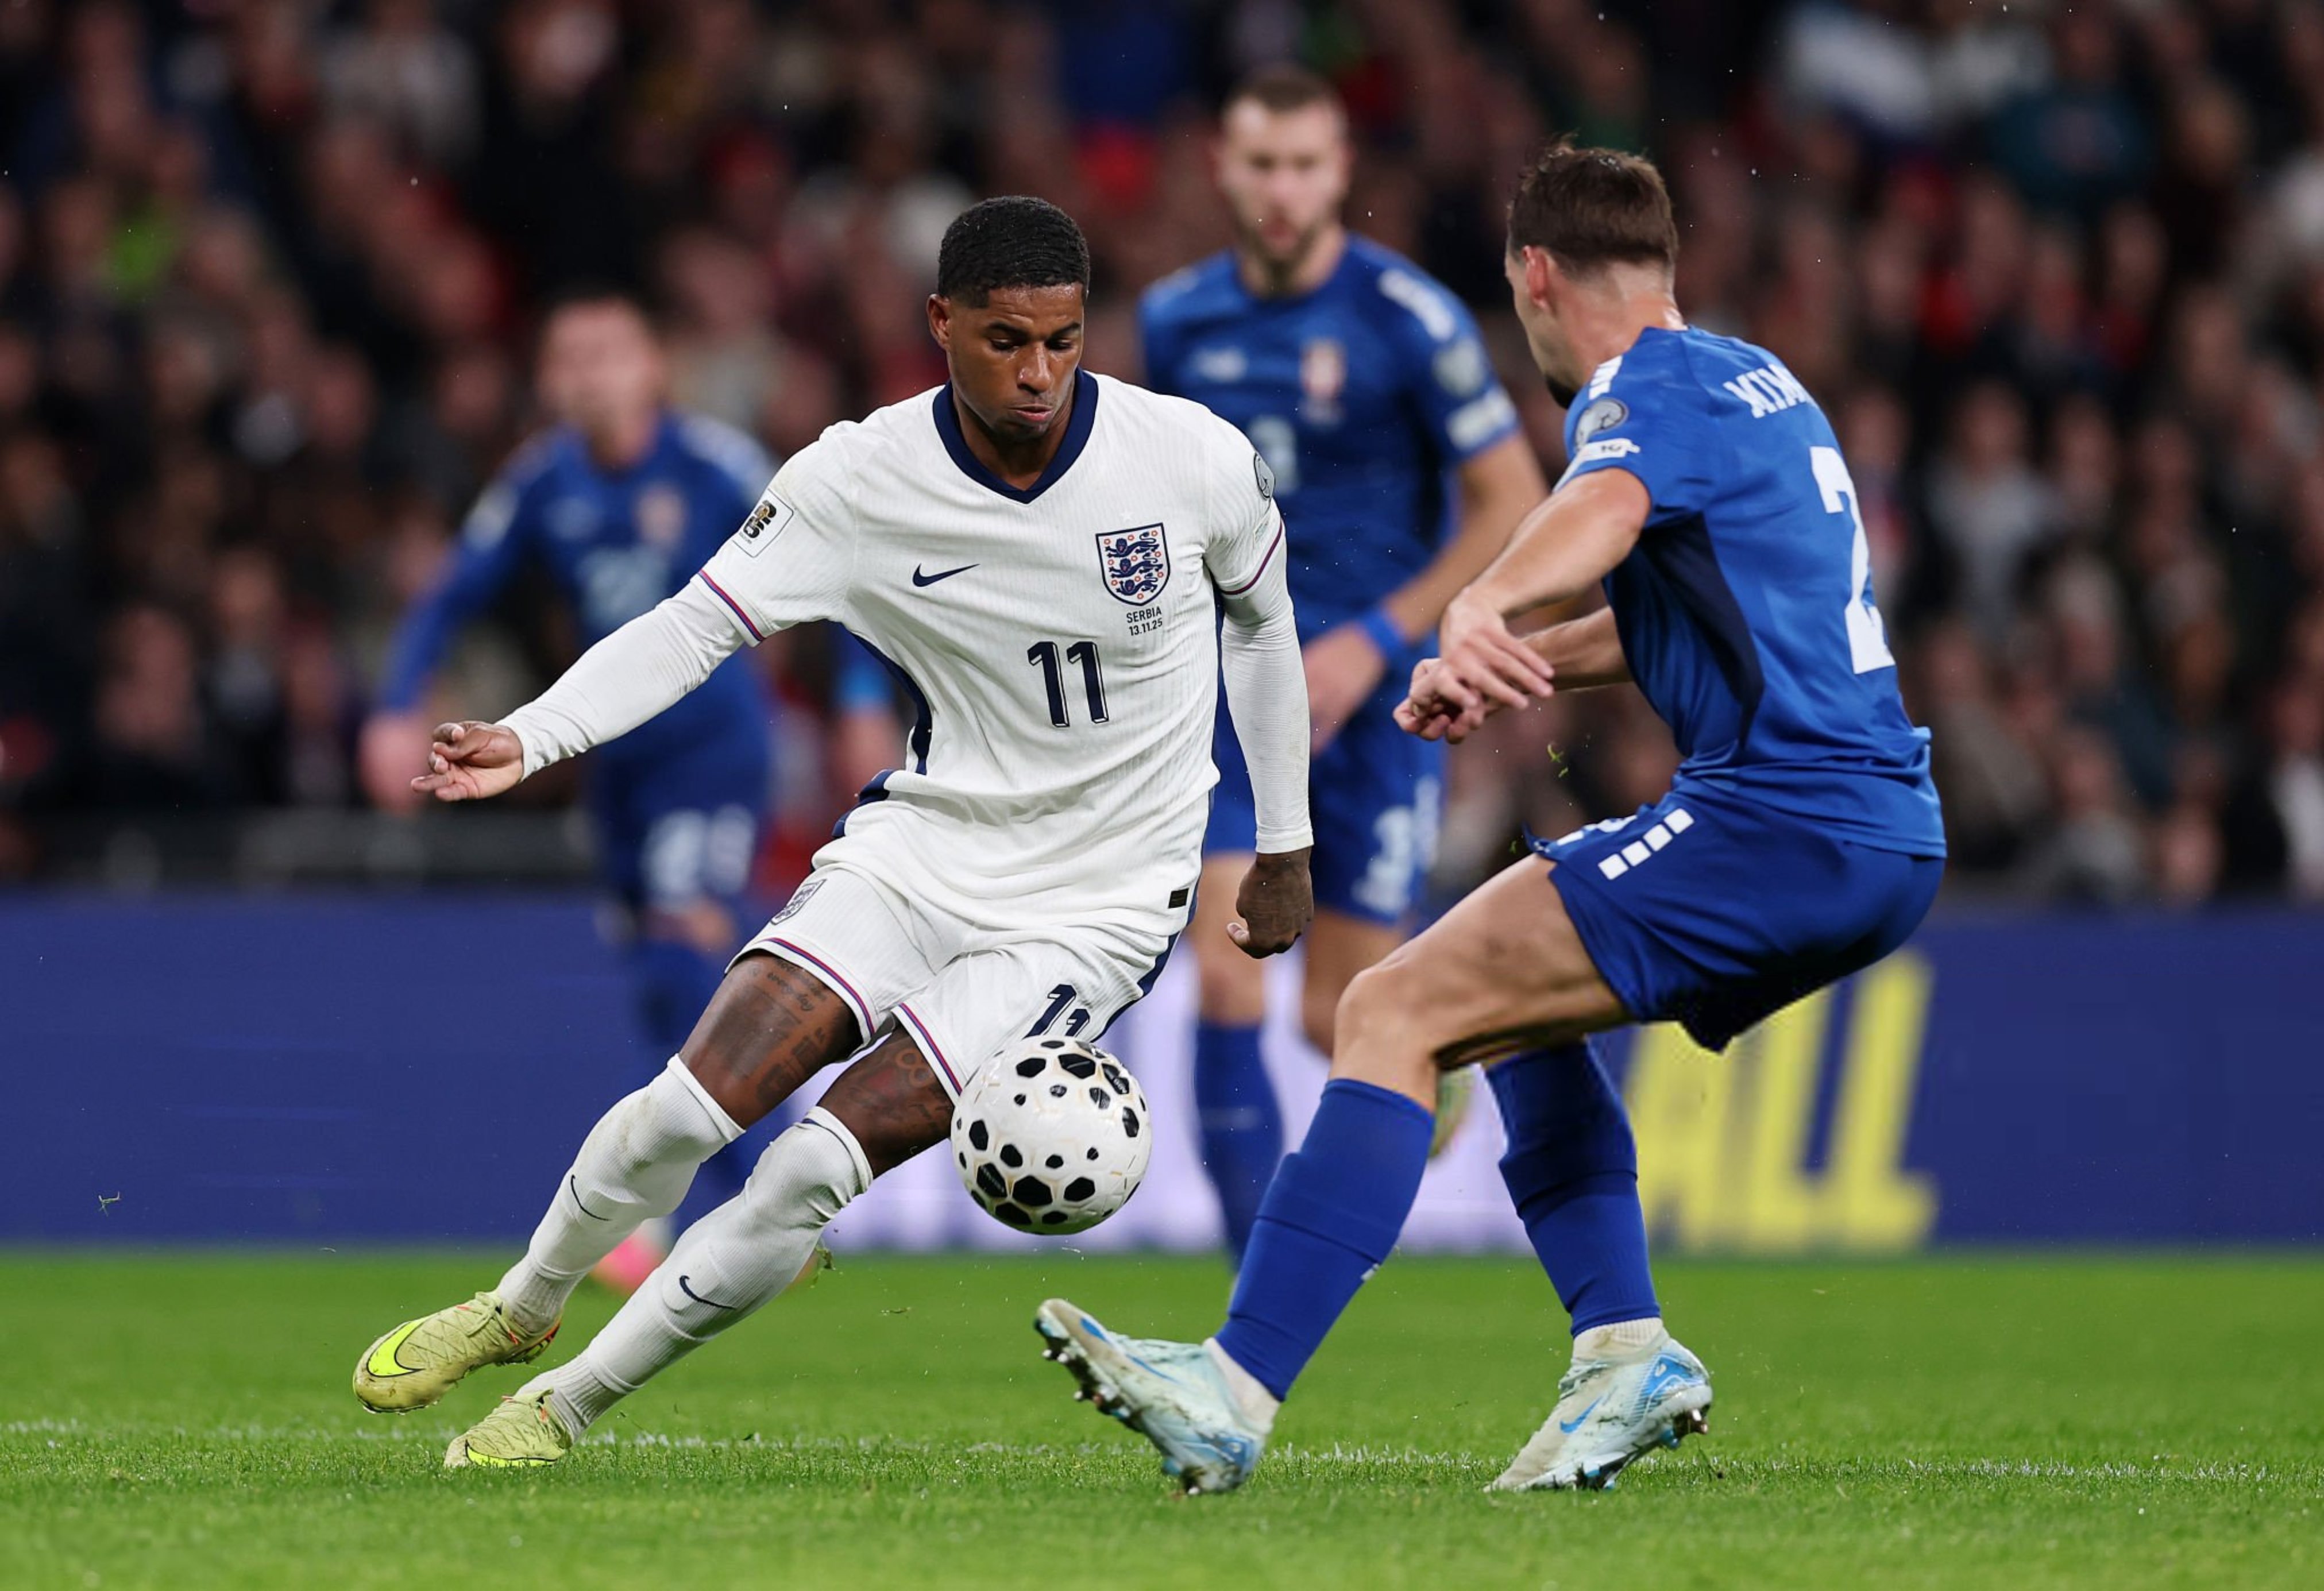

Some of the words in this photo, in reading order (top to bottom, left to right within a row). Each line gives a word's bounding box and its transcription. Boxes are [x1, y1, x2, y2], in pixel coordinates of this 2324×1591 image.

[1810, 446, 1896, 674] 2
[1126, 606, 1161, 623] SERBIA
[1129, 617, 1163, 636] 13.11.25
[1027, 642, 1109, 727] 11
